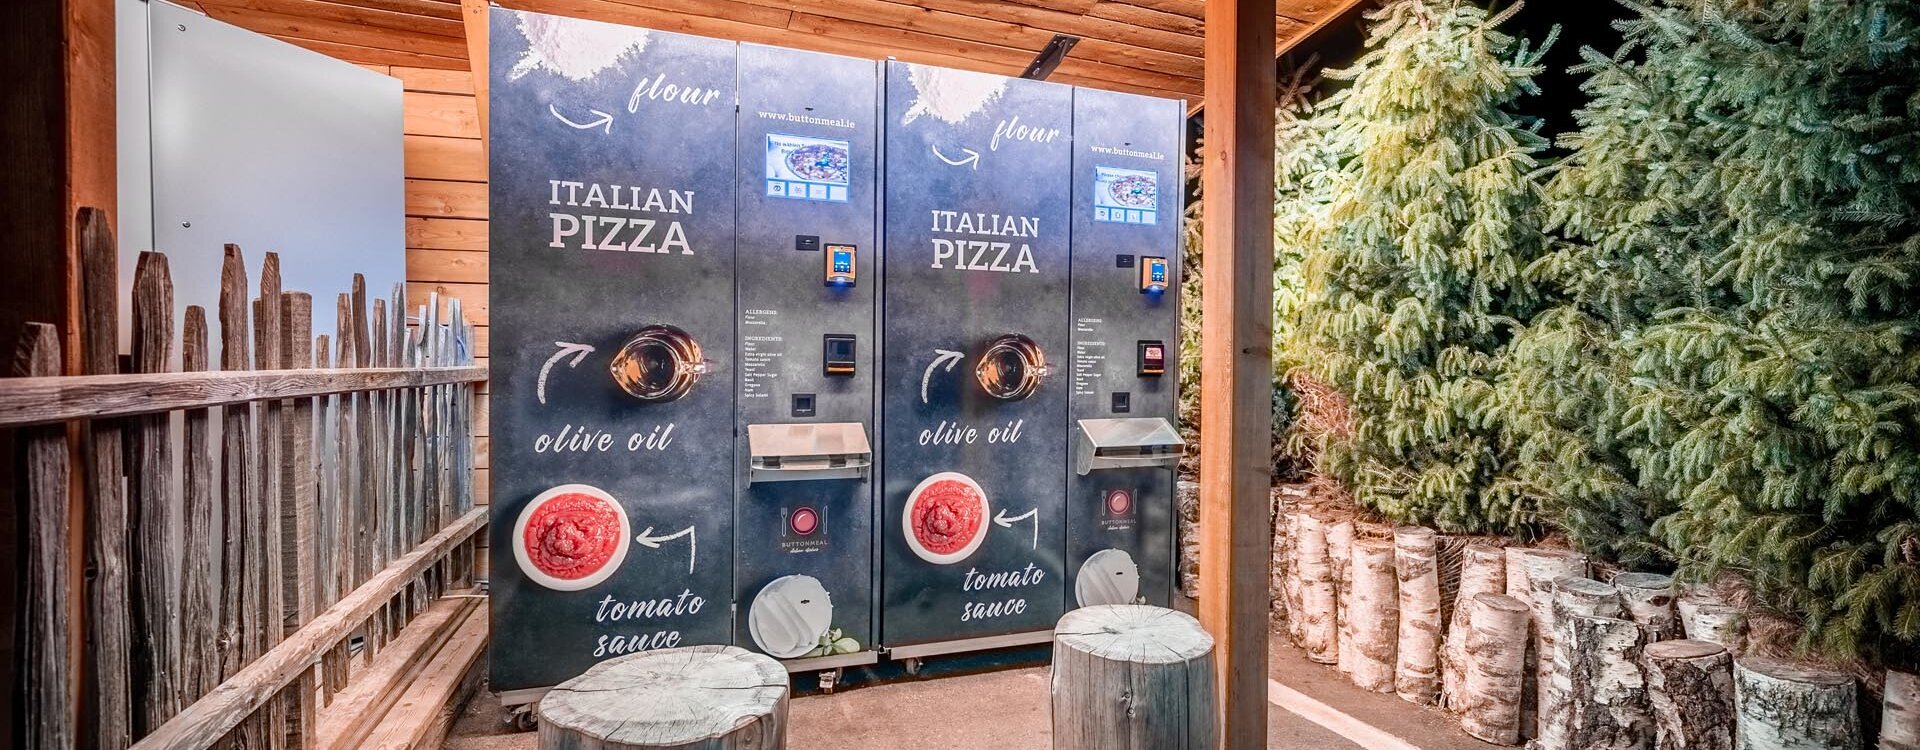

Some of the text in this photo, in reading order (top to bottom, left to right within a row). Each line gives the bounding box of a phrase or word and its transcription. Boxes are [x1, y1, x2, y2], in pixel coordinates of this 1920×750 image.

[628, 73, 720, 113] flour
[758, 111, 856, 129] www.buttonmeal.ie
[990, 115, 1059, 151] flour
[1090, 146, 1165, 160] www.buttonmeal.ie
[549, 179, 695, 214] ITALIAN
[549, 212, 695, 255] PIZZA
[931, 209, 1040, 238] ITALIAN
[931, 238, 1040, 274] PIZZA
[534, 422, 675, 454] olive oil
[919, 419, 1023, 446] olive oil
[781, 540, 828, 548] BUTTONMEAL
[963, 562, 1046, 592] tomato
[596, 588, 706, 622] tomato
[961, 597, 1027, 622] sauce
[593, 631, 682, 657] sauce
